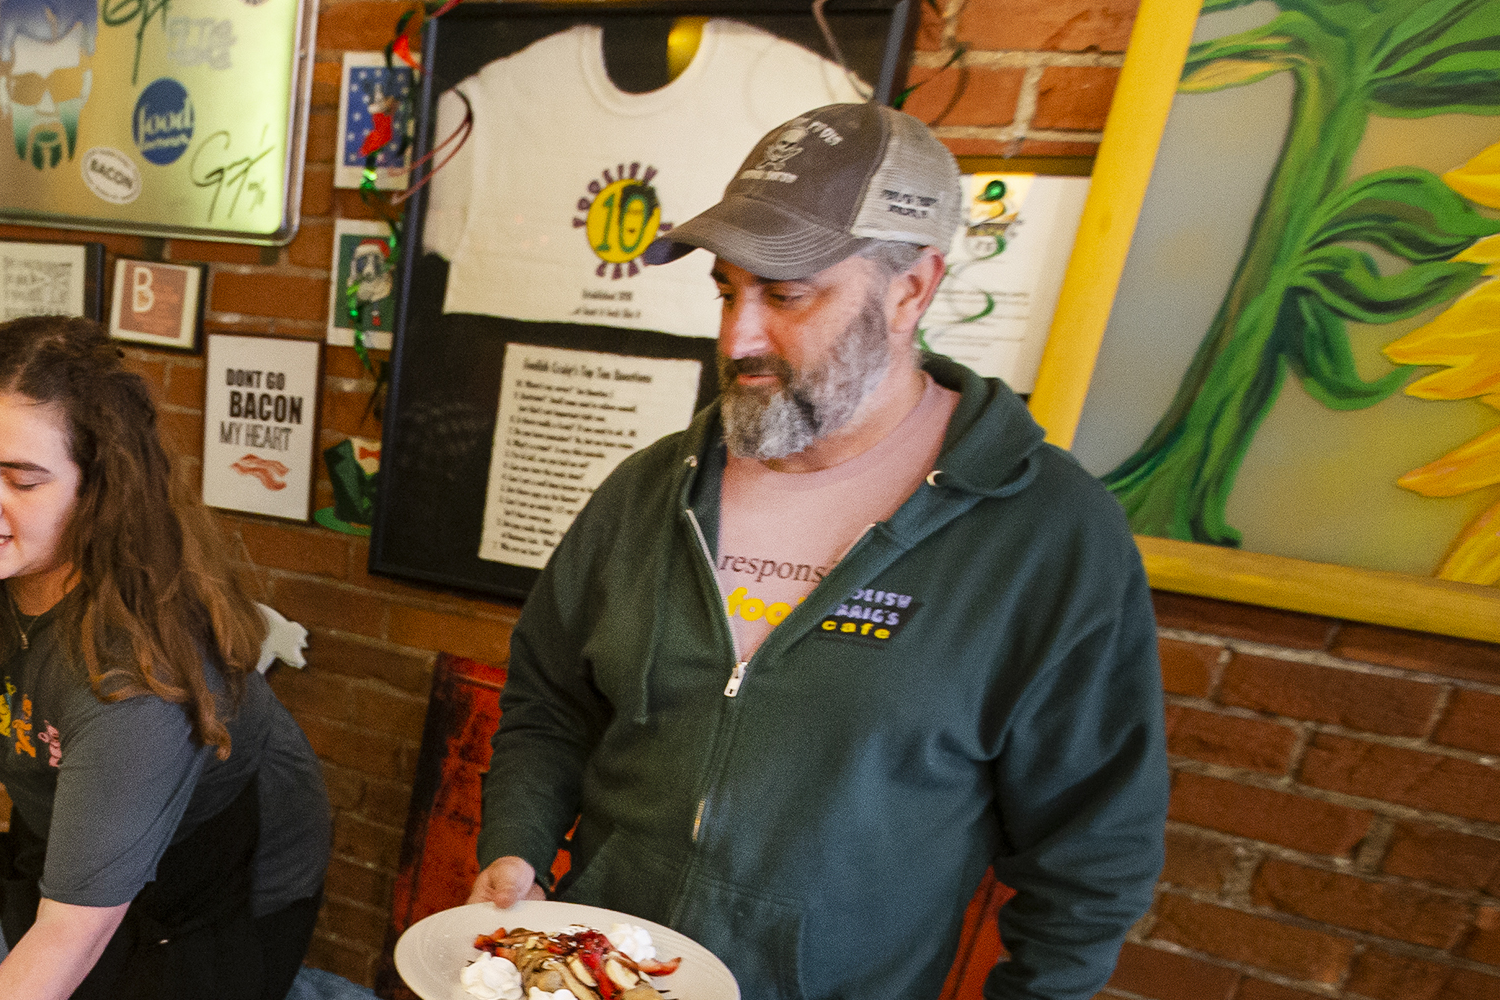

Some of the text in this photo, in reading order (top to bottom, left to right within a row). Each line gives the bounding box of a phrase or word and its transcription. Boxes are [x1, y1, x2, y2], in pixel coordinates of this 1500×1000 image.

[90, 158, 133, 190] BACON
[596, 192, 650, 254] 10
[131, 266, 156, 313] B
[265, 371, 286, 391] GO
[229, 390, 303, 425] BACON
[219, 420, 293, 452] MY HEART
[719, 553, 832, 584] respons
[727, 586, 807, 627] foo
[821, 619, 891, 640] cafe
